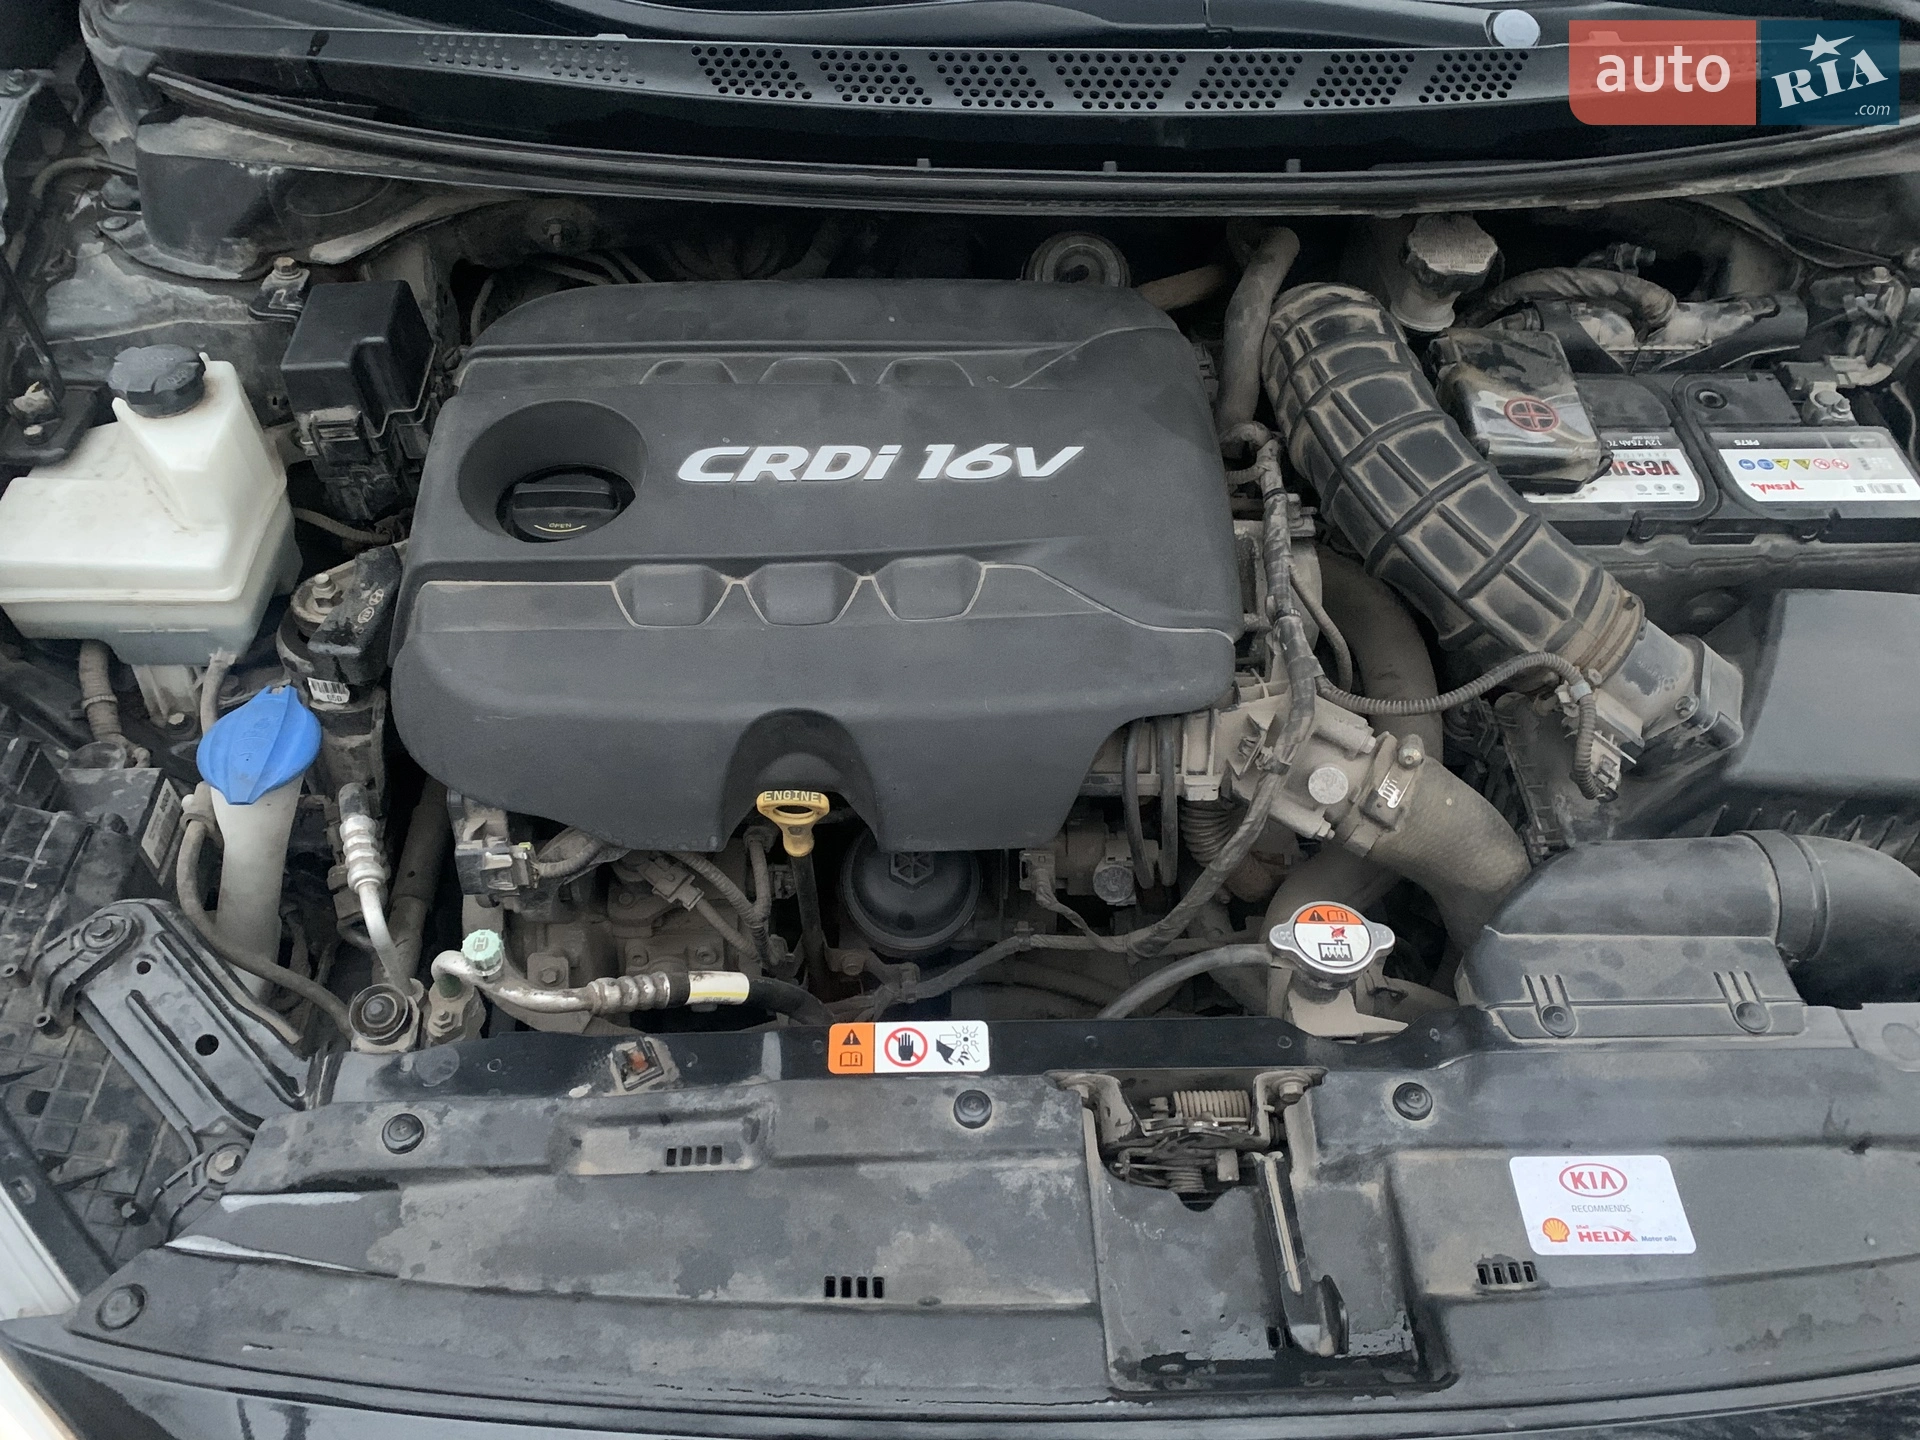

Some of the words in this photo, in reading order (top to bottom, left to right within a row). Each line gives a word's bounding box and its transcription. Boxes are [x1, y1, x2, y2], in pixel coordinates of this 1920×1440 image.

[677, 445, 902, 482] CRDi
[917, 443, 1085, 482] 16V
[764, 790, 820, 801] ENGINE
[1569, 1171, 1618, 1189] KIA
[1571, 1205, 1632, 1213] RECOMMENDS
[1577, 1230, 1637, 1242] HELIX
